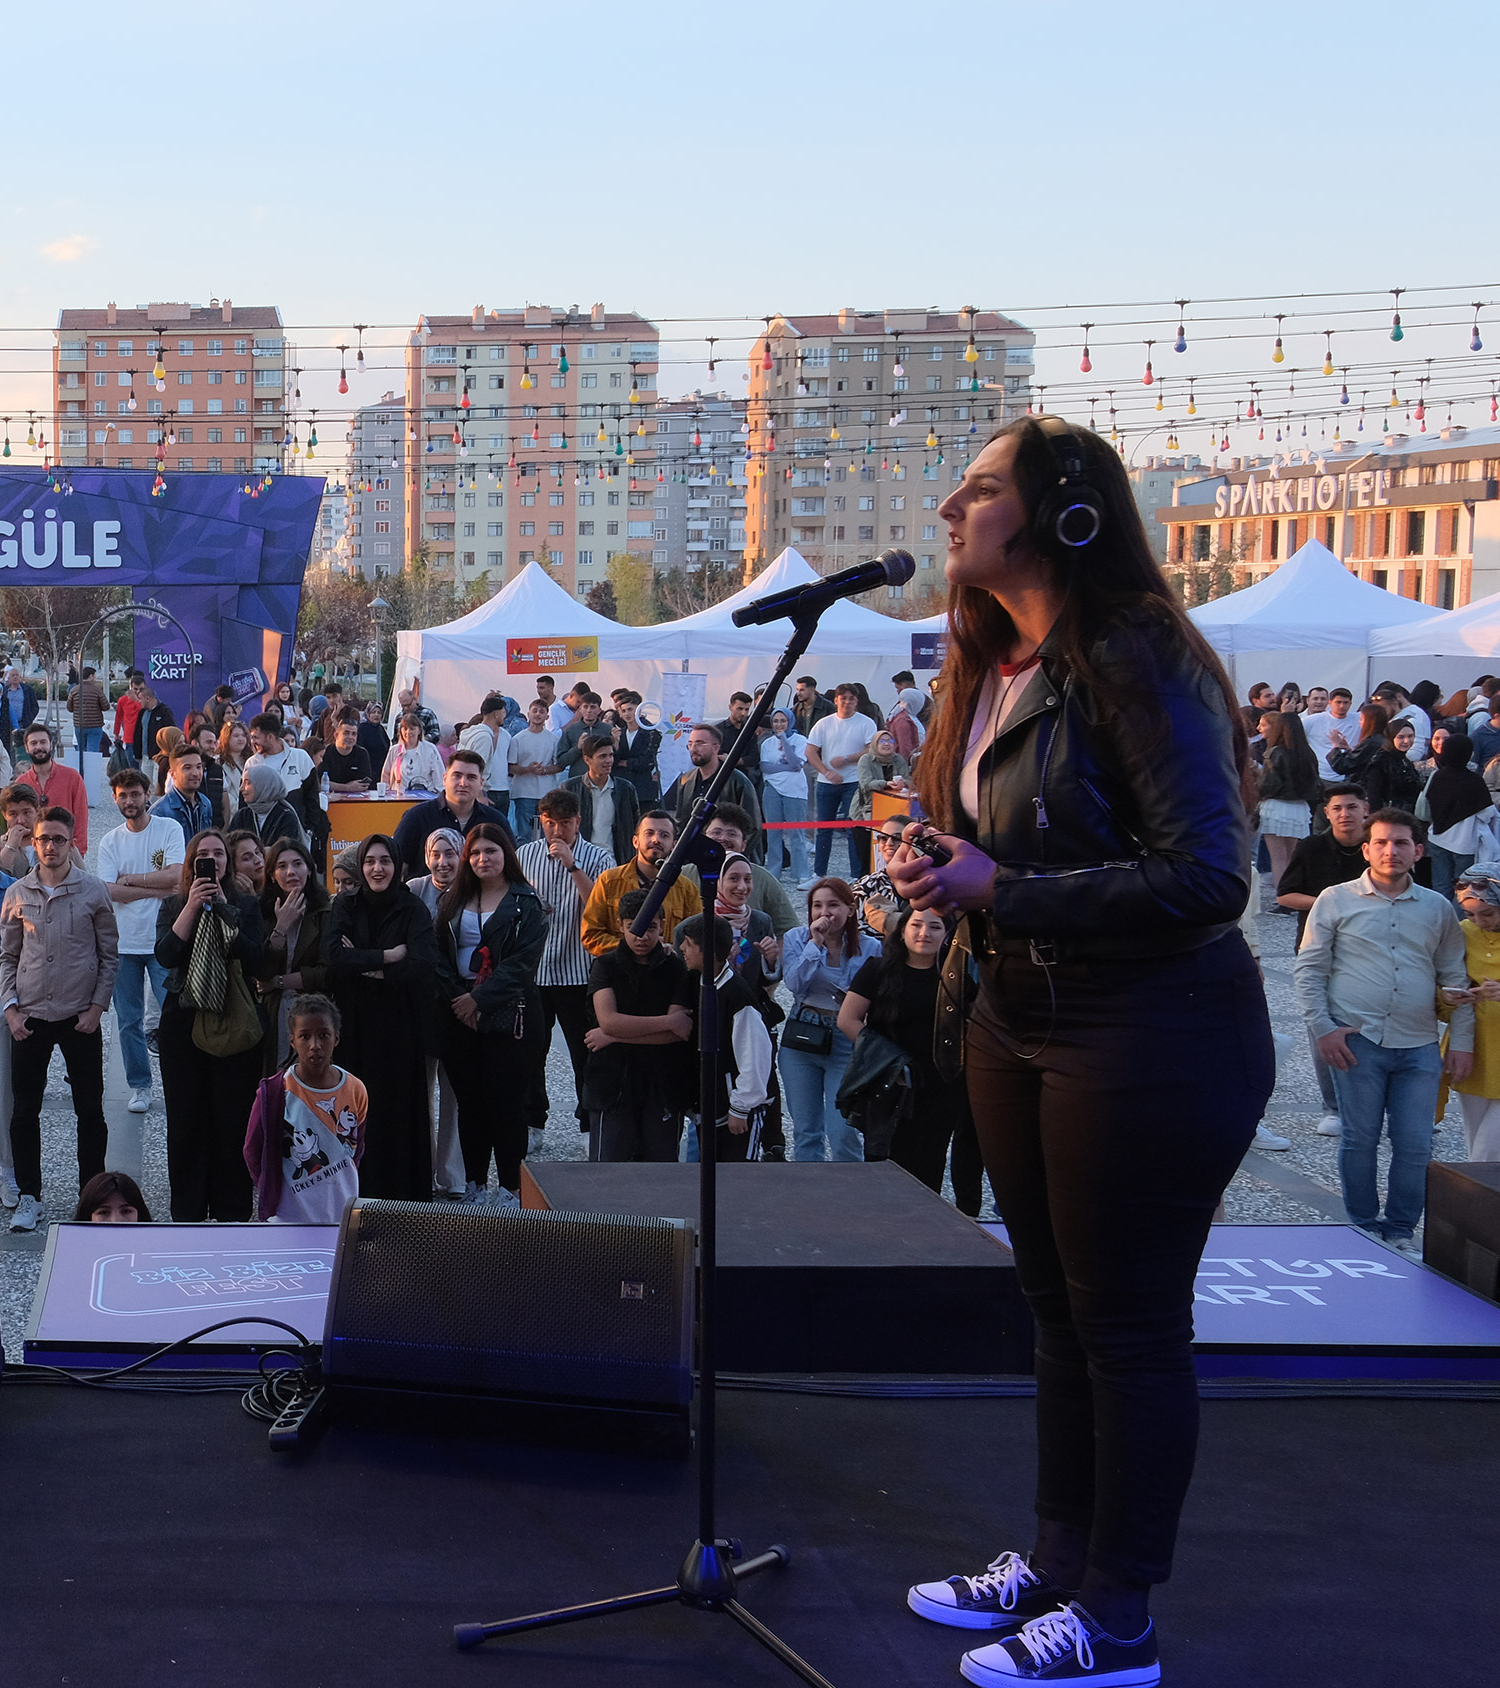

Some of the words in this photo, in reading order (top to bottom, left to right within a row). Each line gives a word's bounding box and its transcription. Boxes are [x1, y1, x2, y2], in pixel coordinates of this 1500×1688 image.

[151, 668, 187, 679] KART
[291, 1178, 315, 1194] ICKEY
[176, 1275, 304, 1297] FEST
